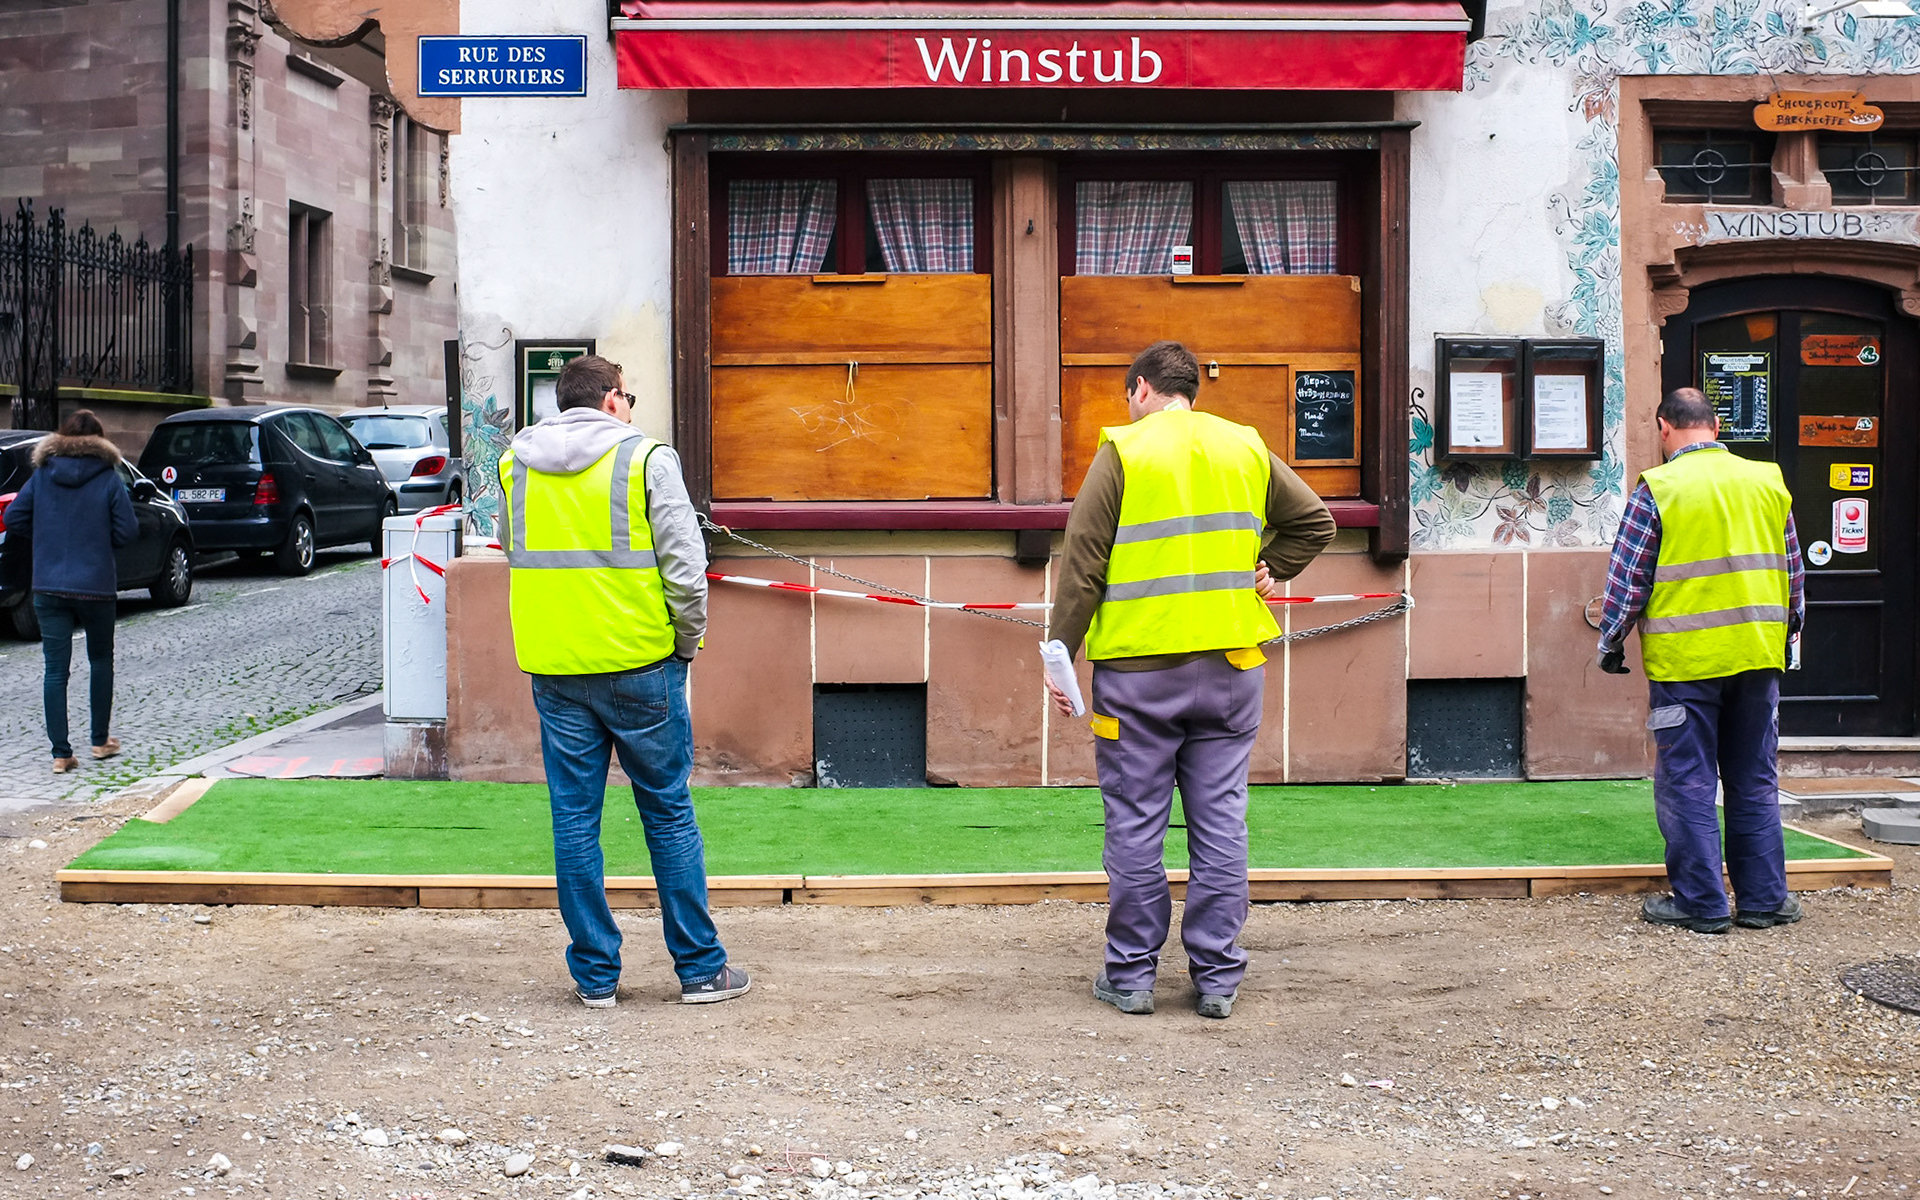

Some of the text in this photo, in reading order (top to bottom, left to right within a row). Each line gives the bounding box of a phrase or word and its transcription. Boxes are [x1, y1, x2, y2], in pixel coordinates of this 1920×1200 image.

[458, 47, 546, 63] RUE DES
[914, 37, 1163, 83] Winstub
[438, 68, 565, 85] SERRURIERS
[1714, 212, 1864, 237] WINSTUB
[166, 468, 174, 479] A
[1841, 526, 1864, 535] Ticket
